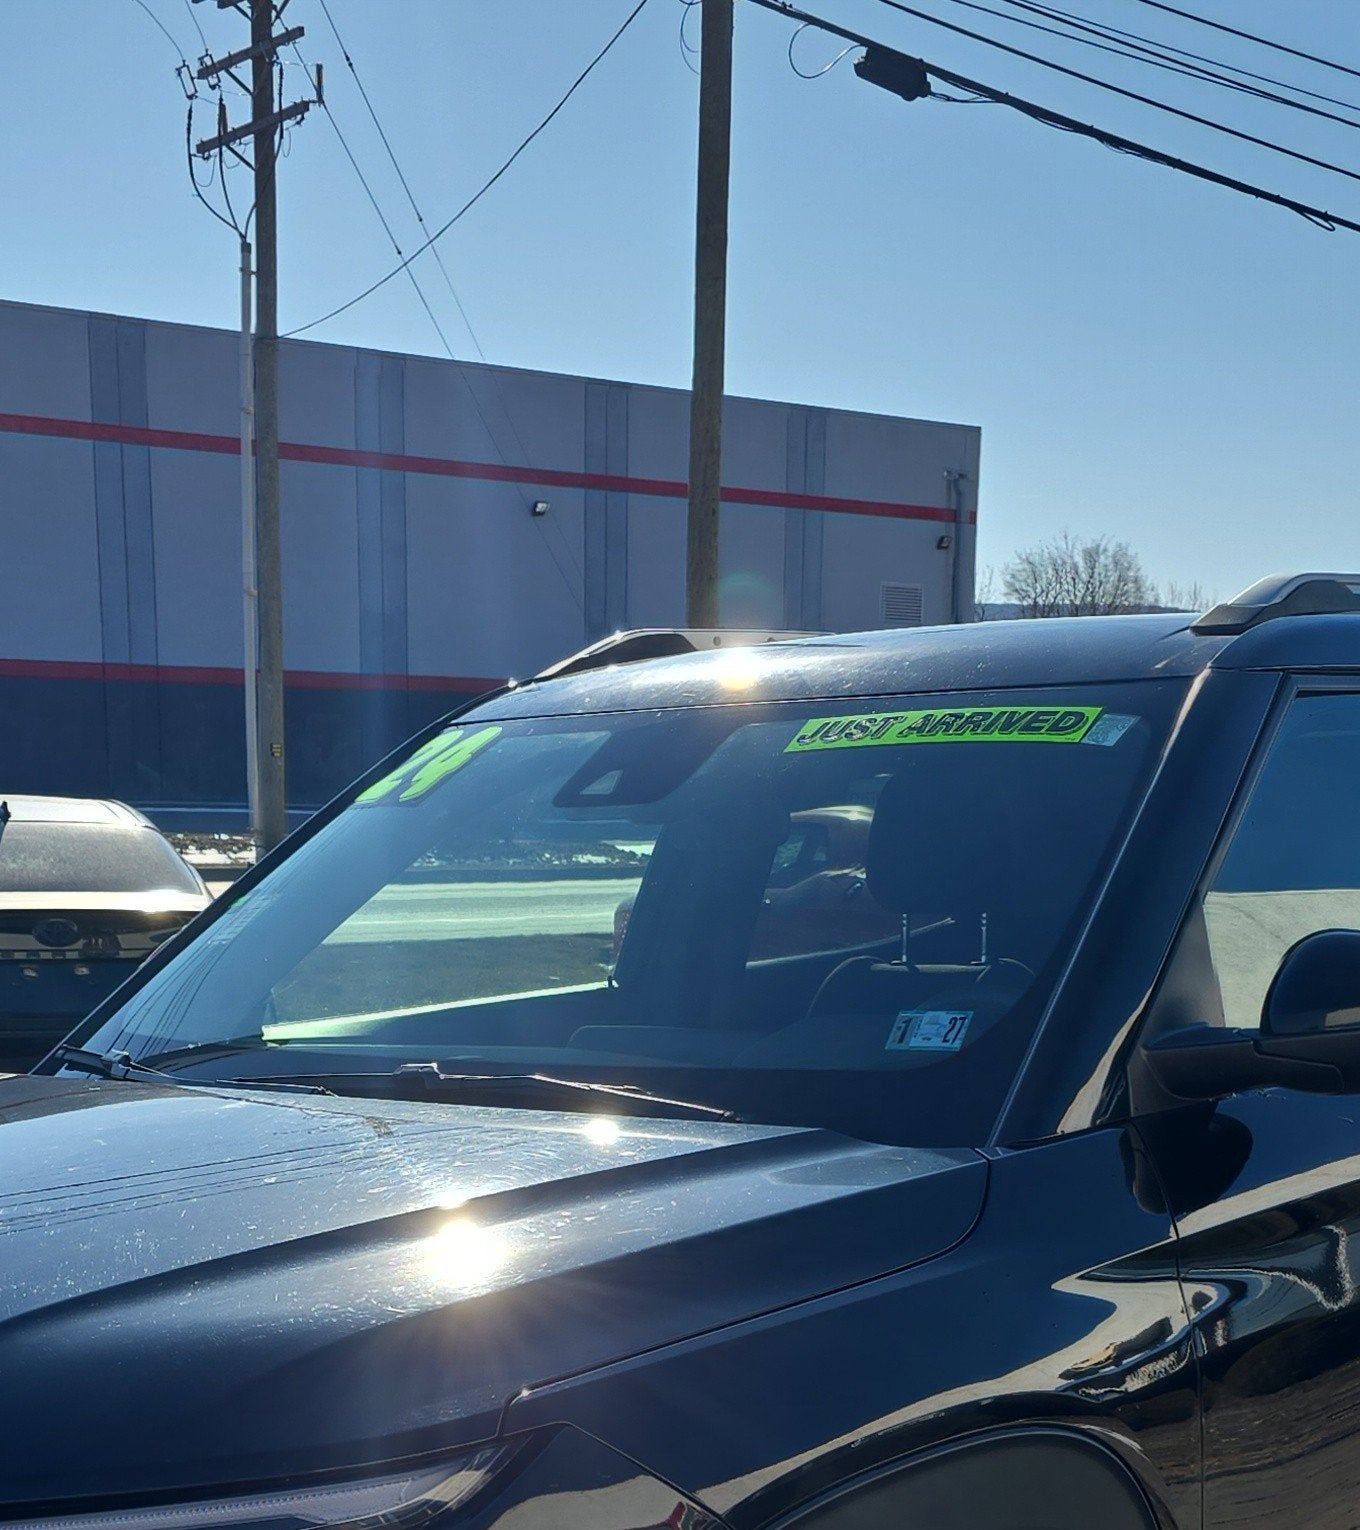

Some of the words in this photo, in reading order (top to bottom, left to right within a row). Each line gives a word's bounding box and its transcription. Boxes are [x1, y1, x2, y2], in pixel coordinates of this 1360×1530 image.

[796, 714, 908, 746] JUST
[898, 709, 1091, 738] ARRIVED
[354, 726, 503, 803] 24
[942, 1016, 967, 1044] 27
